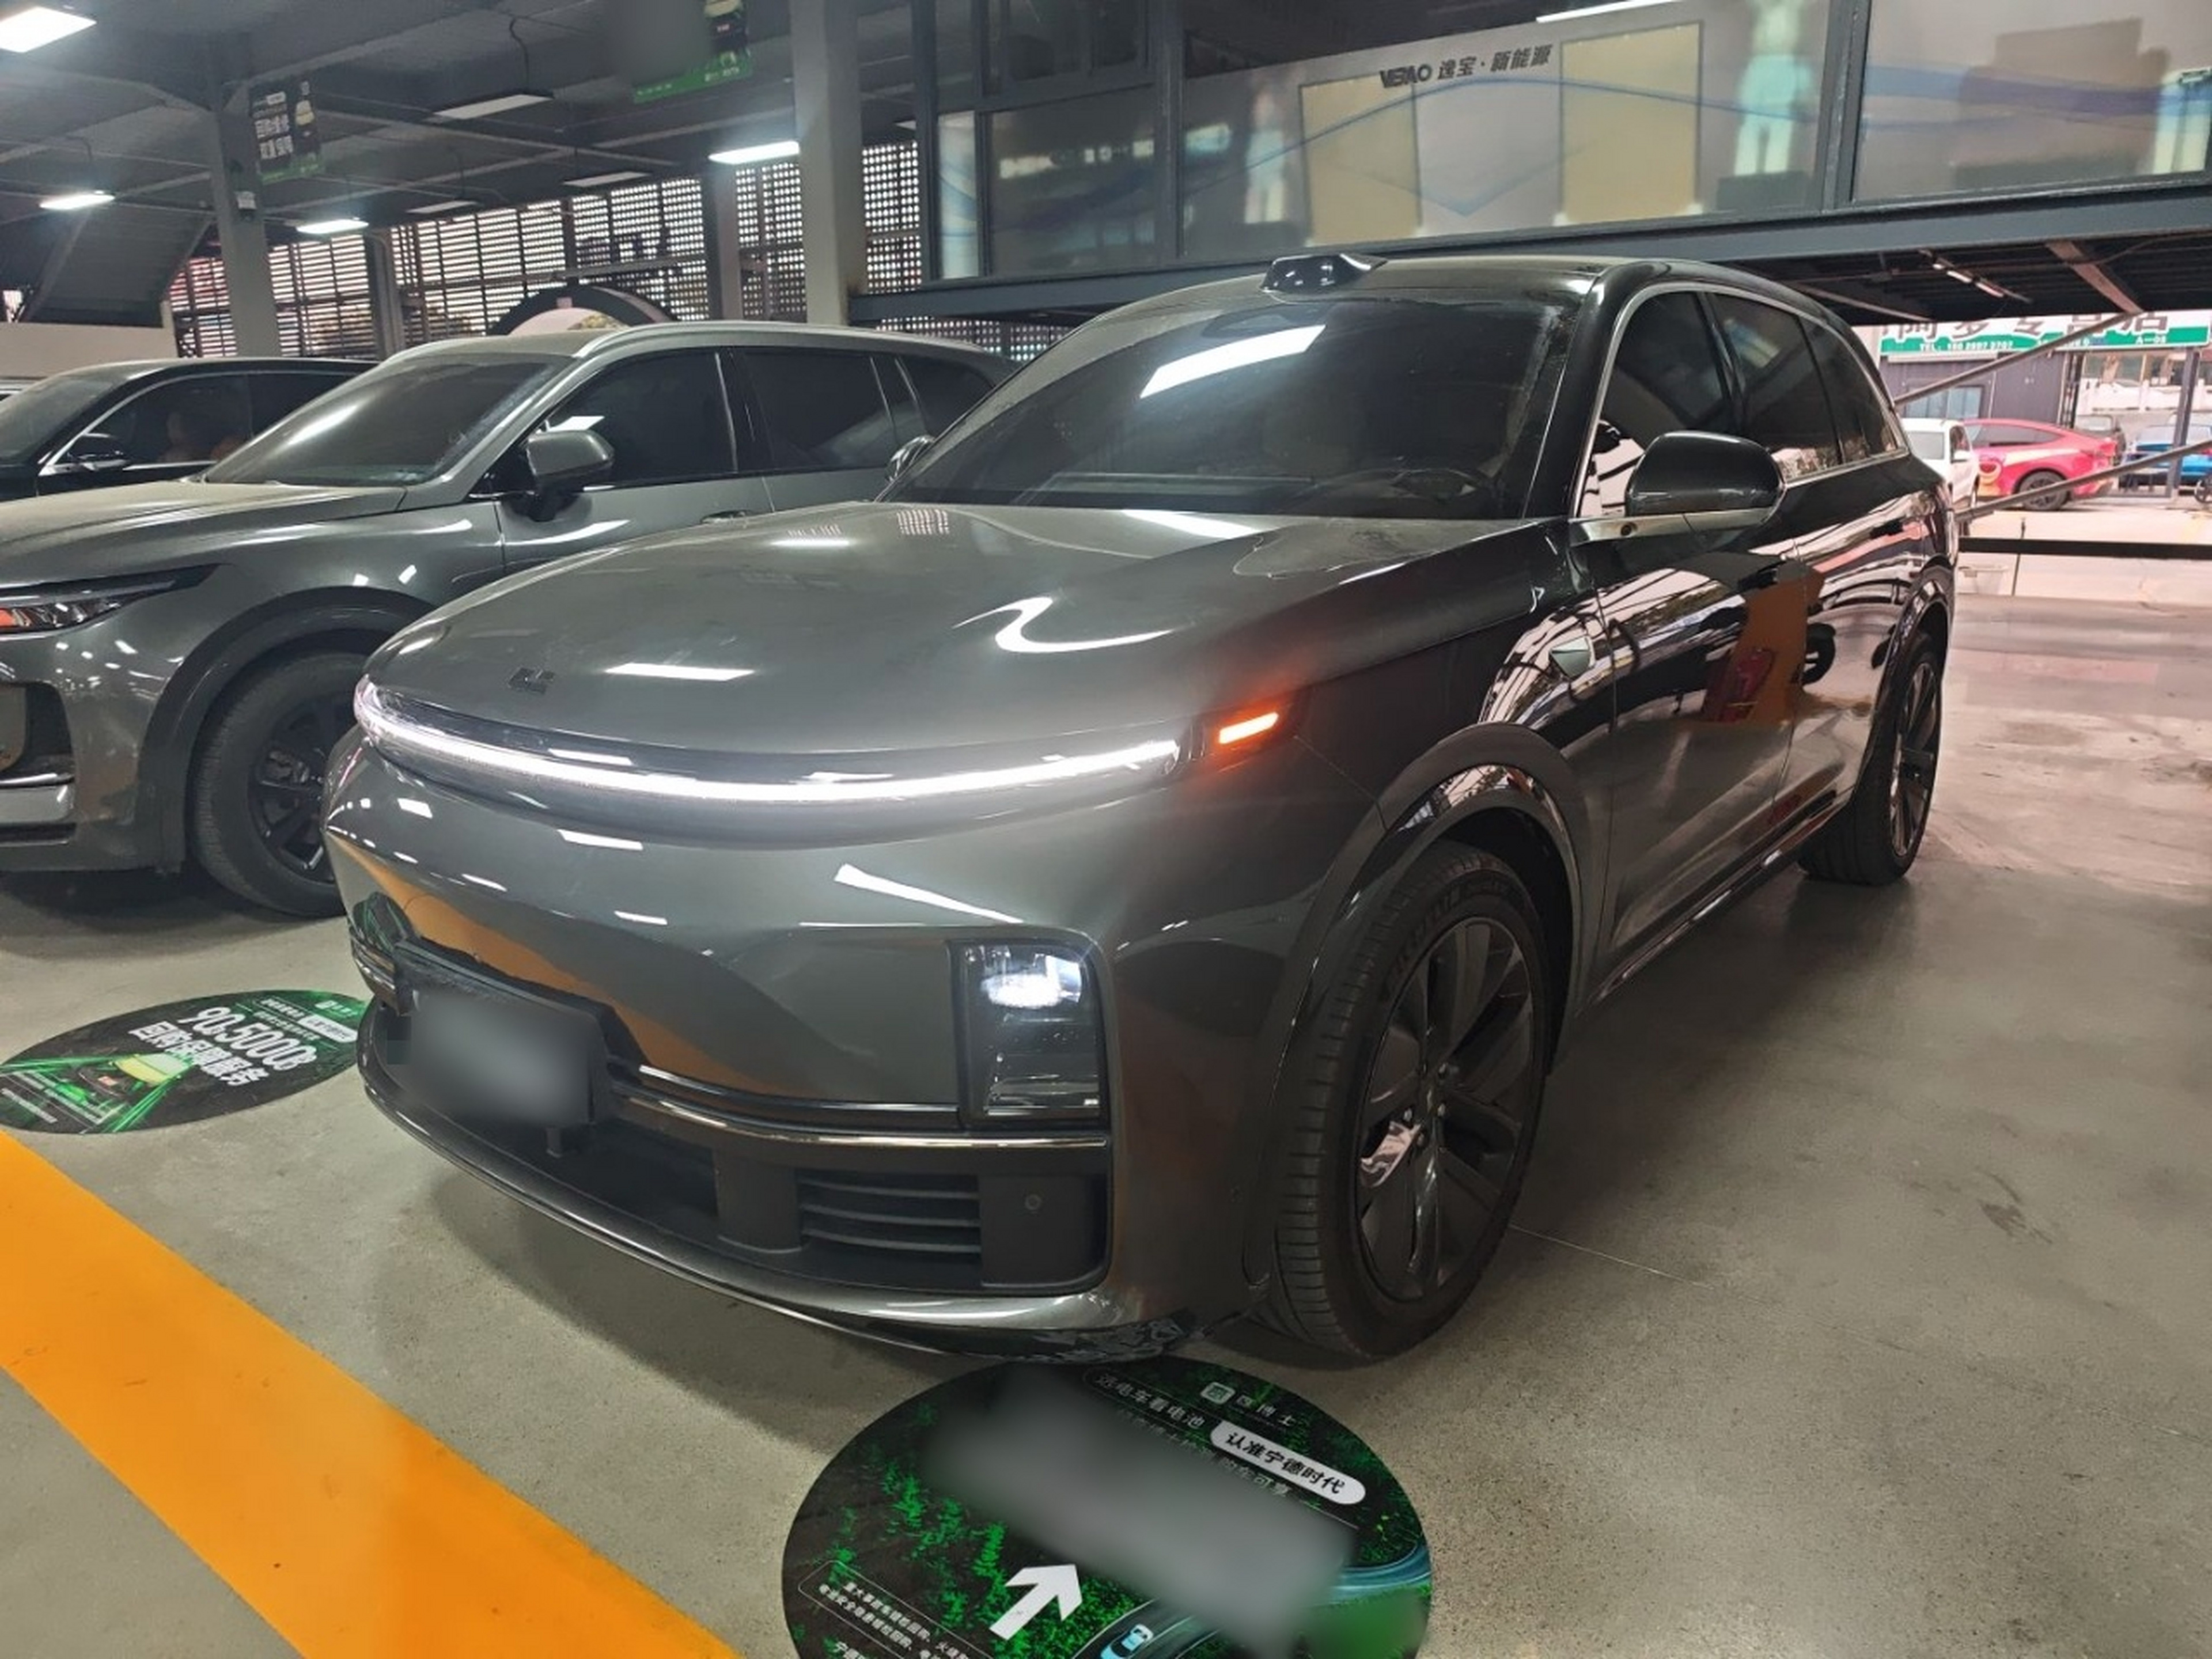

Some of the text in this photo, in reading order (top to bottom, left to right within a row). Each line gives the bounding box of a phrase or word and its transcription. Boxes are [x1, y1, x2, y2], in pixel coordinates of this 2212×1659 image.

[1225, 1431, 1346, 1495] 认准宁德时代
